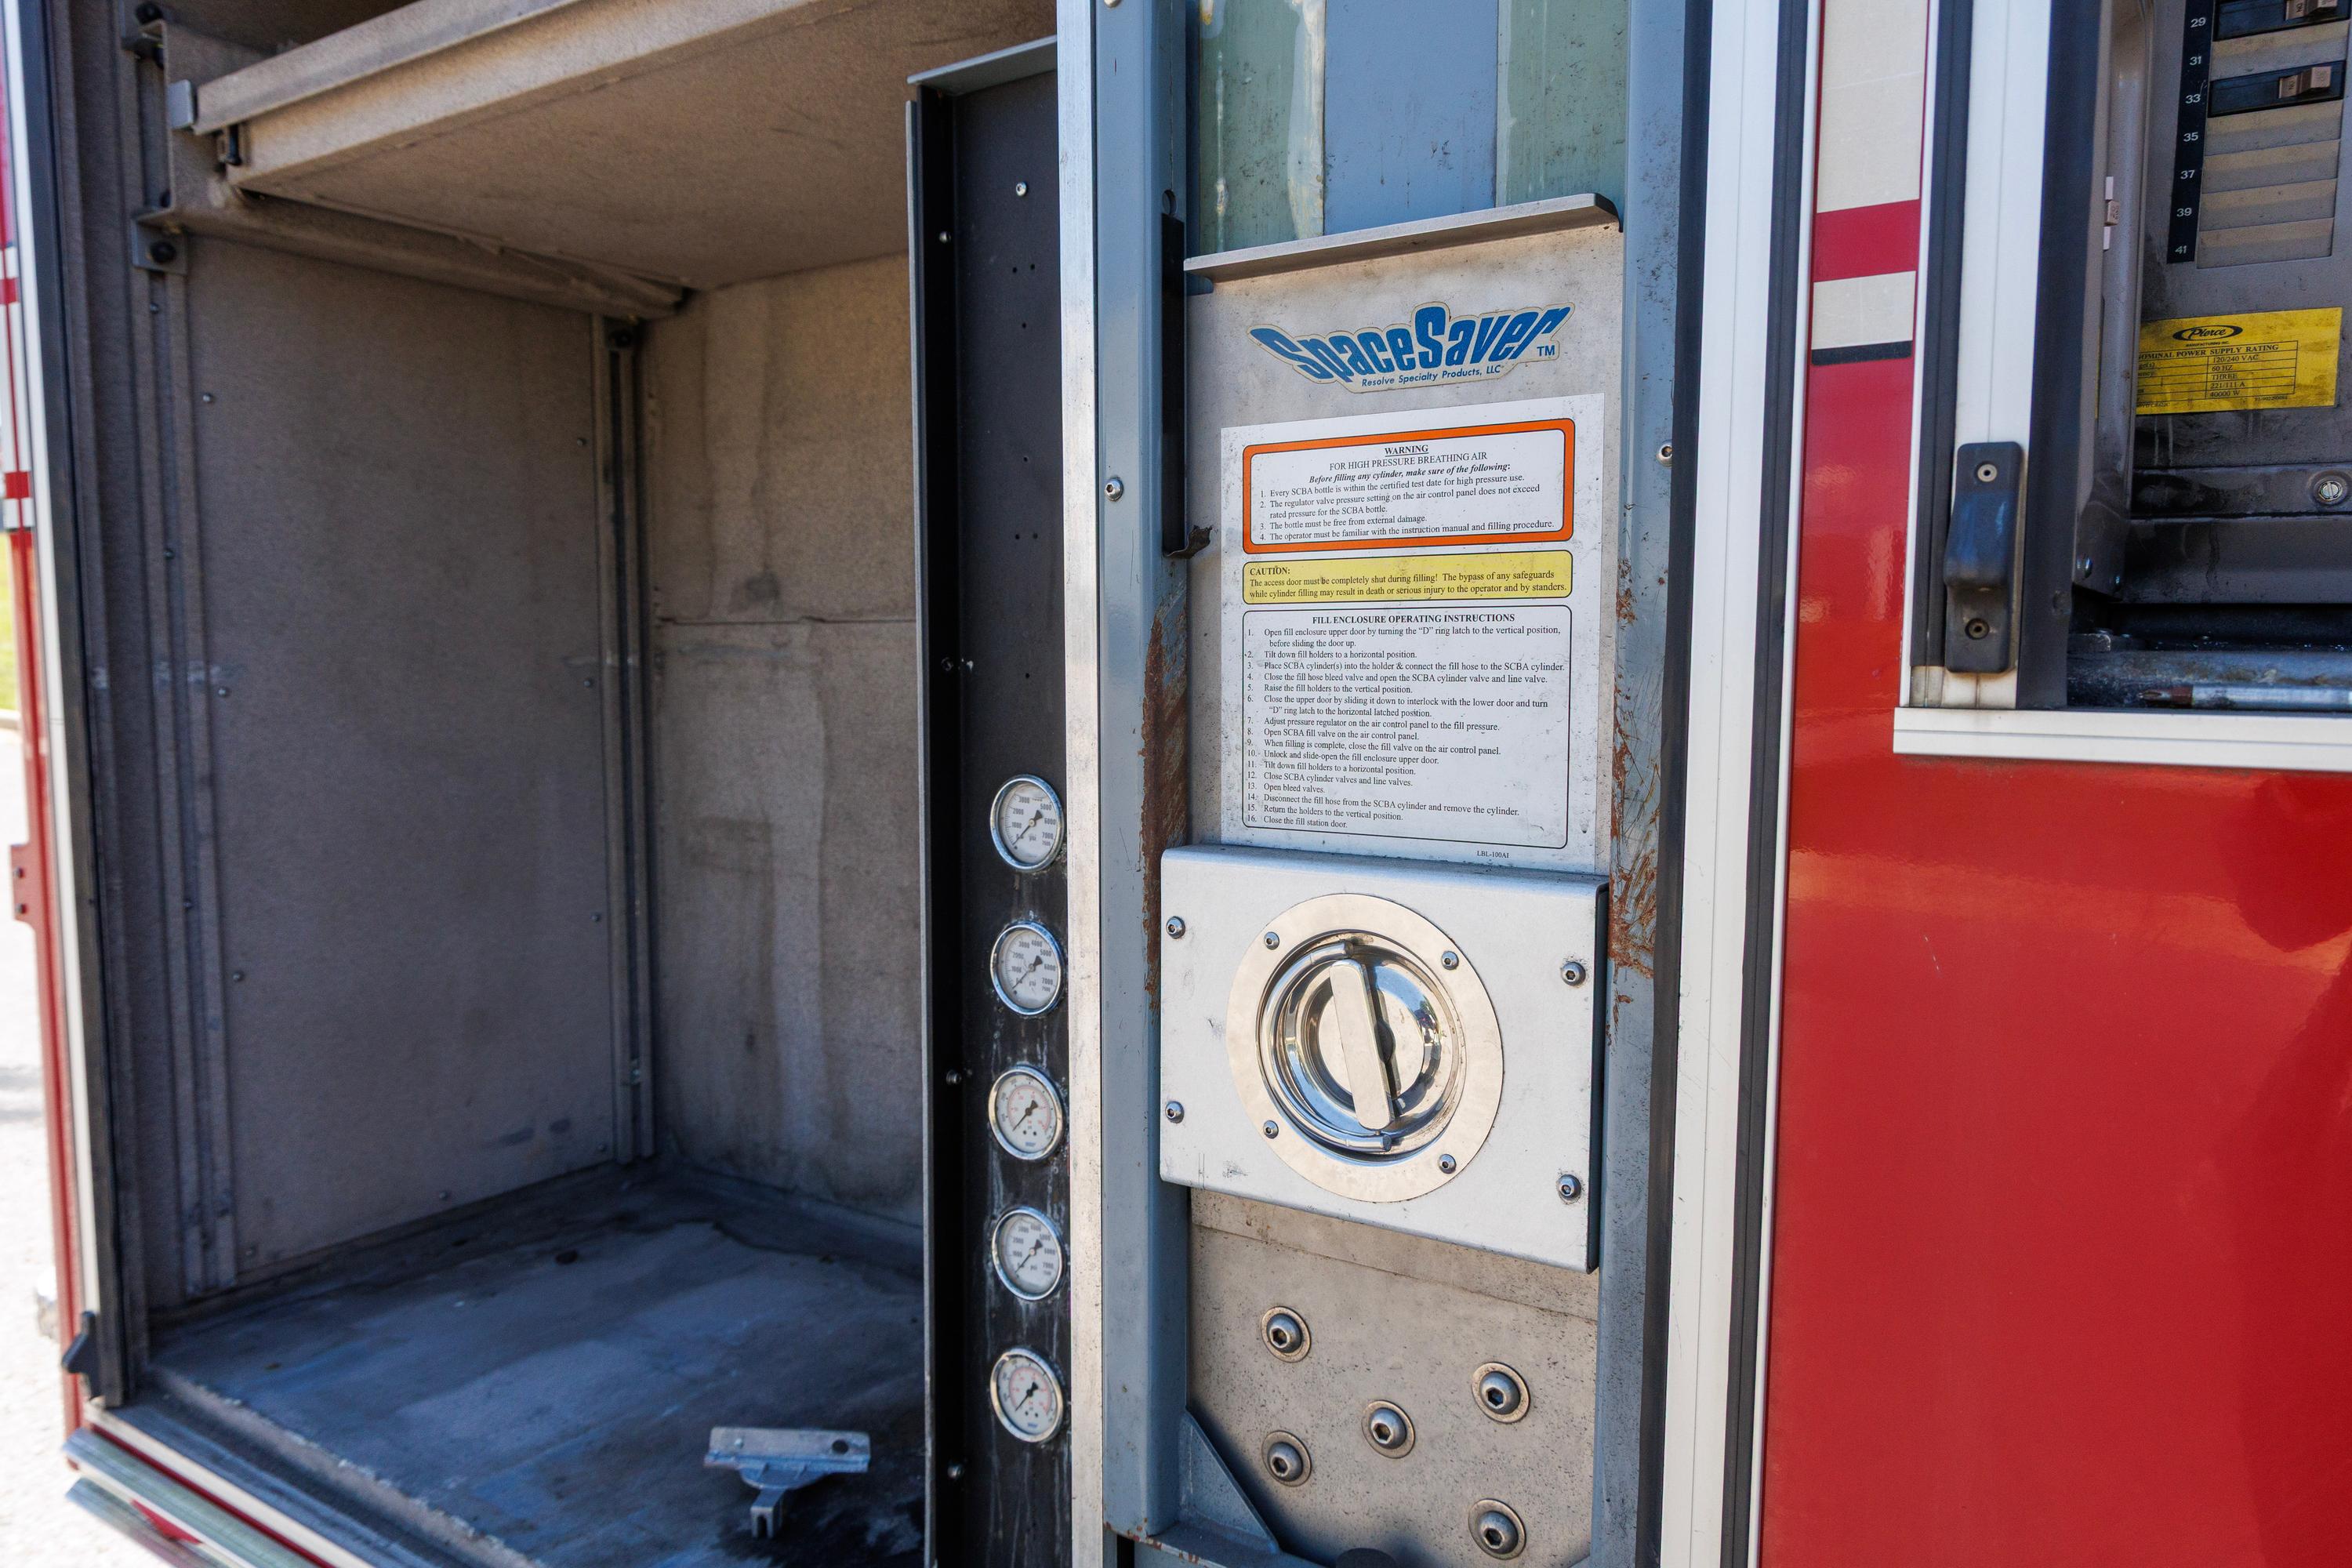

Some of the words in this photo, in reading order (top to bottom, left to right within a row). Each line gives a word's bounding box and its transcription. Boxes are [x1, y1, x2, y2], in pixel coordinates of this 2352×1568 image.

[2190, 17, 2206, 28] 29
[2189, 56, 2201, 66] 31
[2185, 94, 2201, 104] 33
[2183, 132, 2198, 142] 35
[2180, 169, 2195, 180] 37
[2176, 208, 2192, 217] 39
[2175, 245, 2187, 254] 41
[2189, 327, 2227, 340] Pierce
[1250, 306, 1571, 383] SpaceSaver
[2209, 347, 2241, 355] SUPPLY
[2246, 343, 2279, 352] RATING
[1537, 345, 1555, 357] TM
[2212, 355, 2240, 364] 120/240
[1361, 377, 1395, 387] Resolve
[1398, 372, 1439, 385] Specialty
[1441, 368, 1482, 379] Products,
[1485, 365, 1501, 375] LLC
[1385, 445, 1428, 456] WARNING
[1371, 456, 1415, 467] PRESSURE
[1417, 452, 1469, 465] BREATHING
[1334, 474, 1356, 484] filling
[1372, 470, 1403, 481] cylinder,
[1447, 466, 1455, 474] of
[1468, 463, 1510, 474] following:
[1314, 485, 1334, 493] bottle
[1343, 482, 1365, 492] within
[1379, 481, 1410, 489] certified
[1456, 477, 1473, 486] high
[1475, 477, 1507, 485] pressure
[1367, 515, 1395, 524] external
[1396, 515, 1427, 524] damage.
[1249, 567, 1290, 575] CAUTION:
[1331, 576, 1369, 586] completely
[1388, 574, 1410, 584] during
[1414, 574, 1438, 583] filling!
[1459, 573, 1484, 583] bypass
[1513, 571, 1554, 581] safeguards
[1333, 615, 1386, 624] ENCLOSURE
[1386, 651, 1417, 659] position.
[1381, 685, 1413, 695] position.
[1265, 728, 1281, 737] Open
[1399, 732, 1419, 741] panel.
[1302, 750, 1338, 762] slide-open
[1264, 783, 1281, 793] Open
[1477, 850, 1509, 858] LBL-100AI
